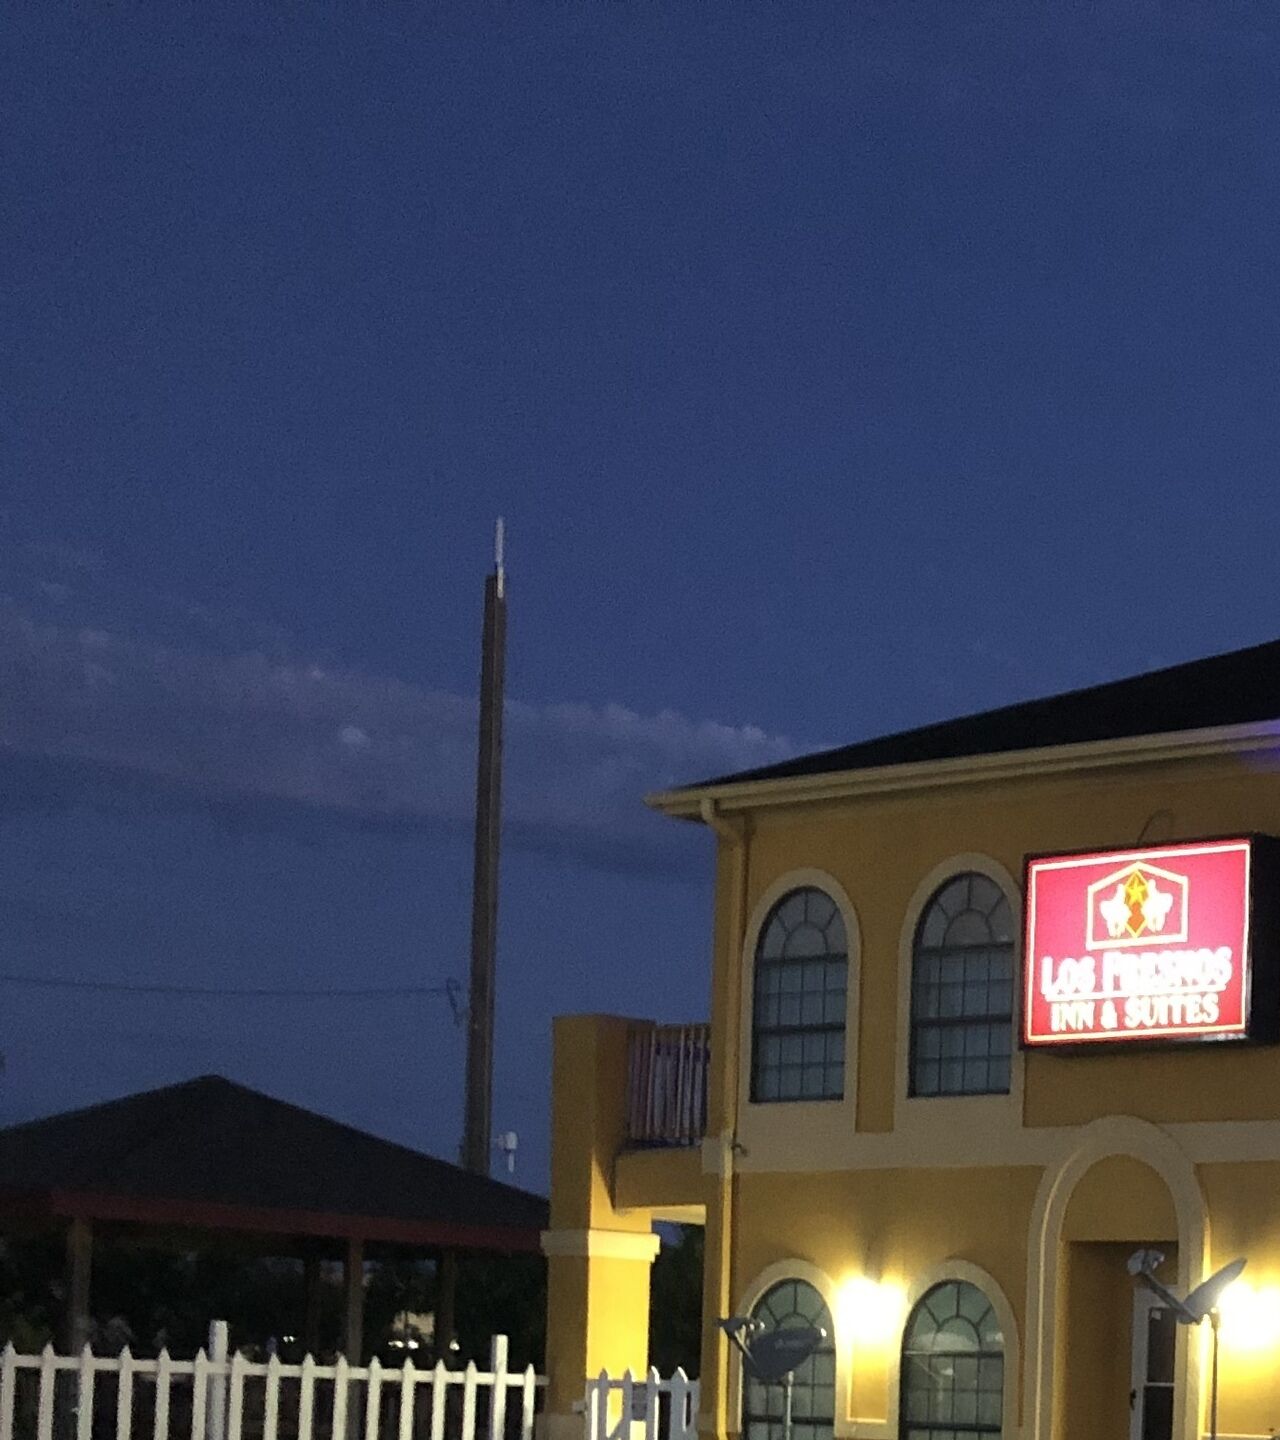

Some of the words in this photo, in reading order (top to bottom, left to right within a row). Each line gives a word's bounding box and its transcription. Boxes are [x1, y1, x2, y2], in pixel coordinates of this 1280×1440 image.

[1052, 1001, 1094, 1030] INN
[1101, 1000, 1117, 1028] &
[1125, 993, 1218, 1027] SUITES
